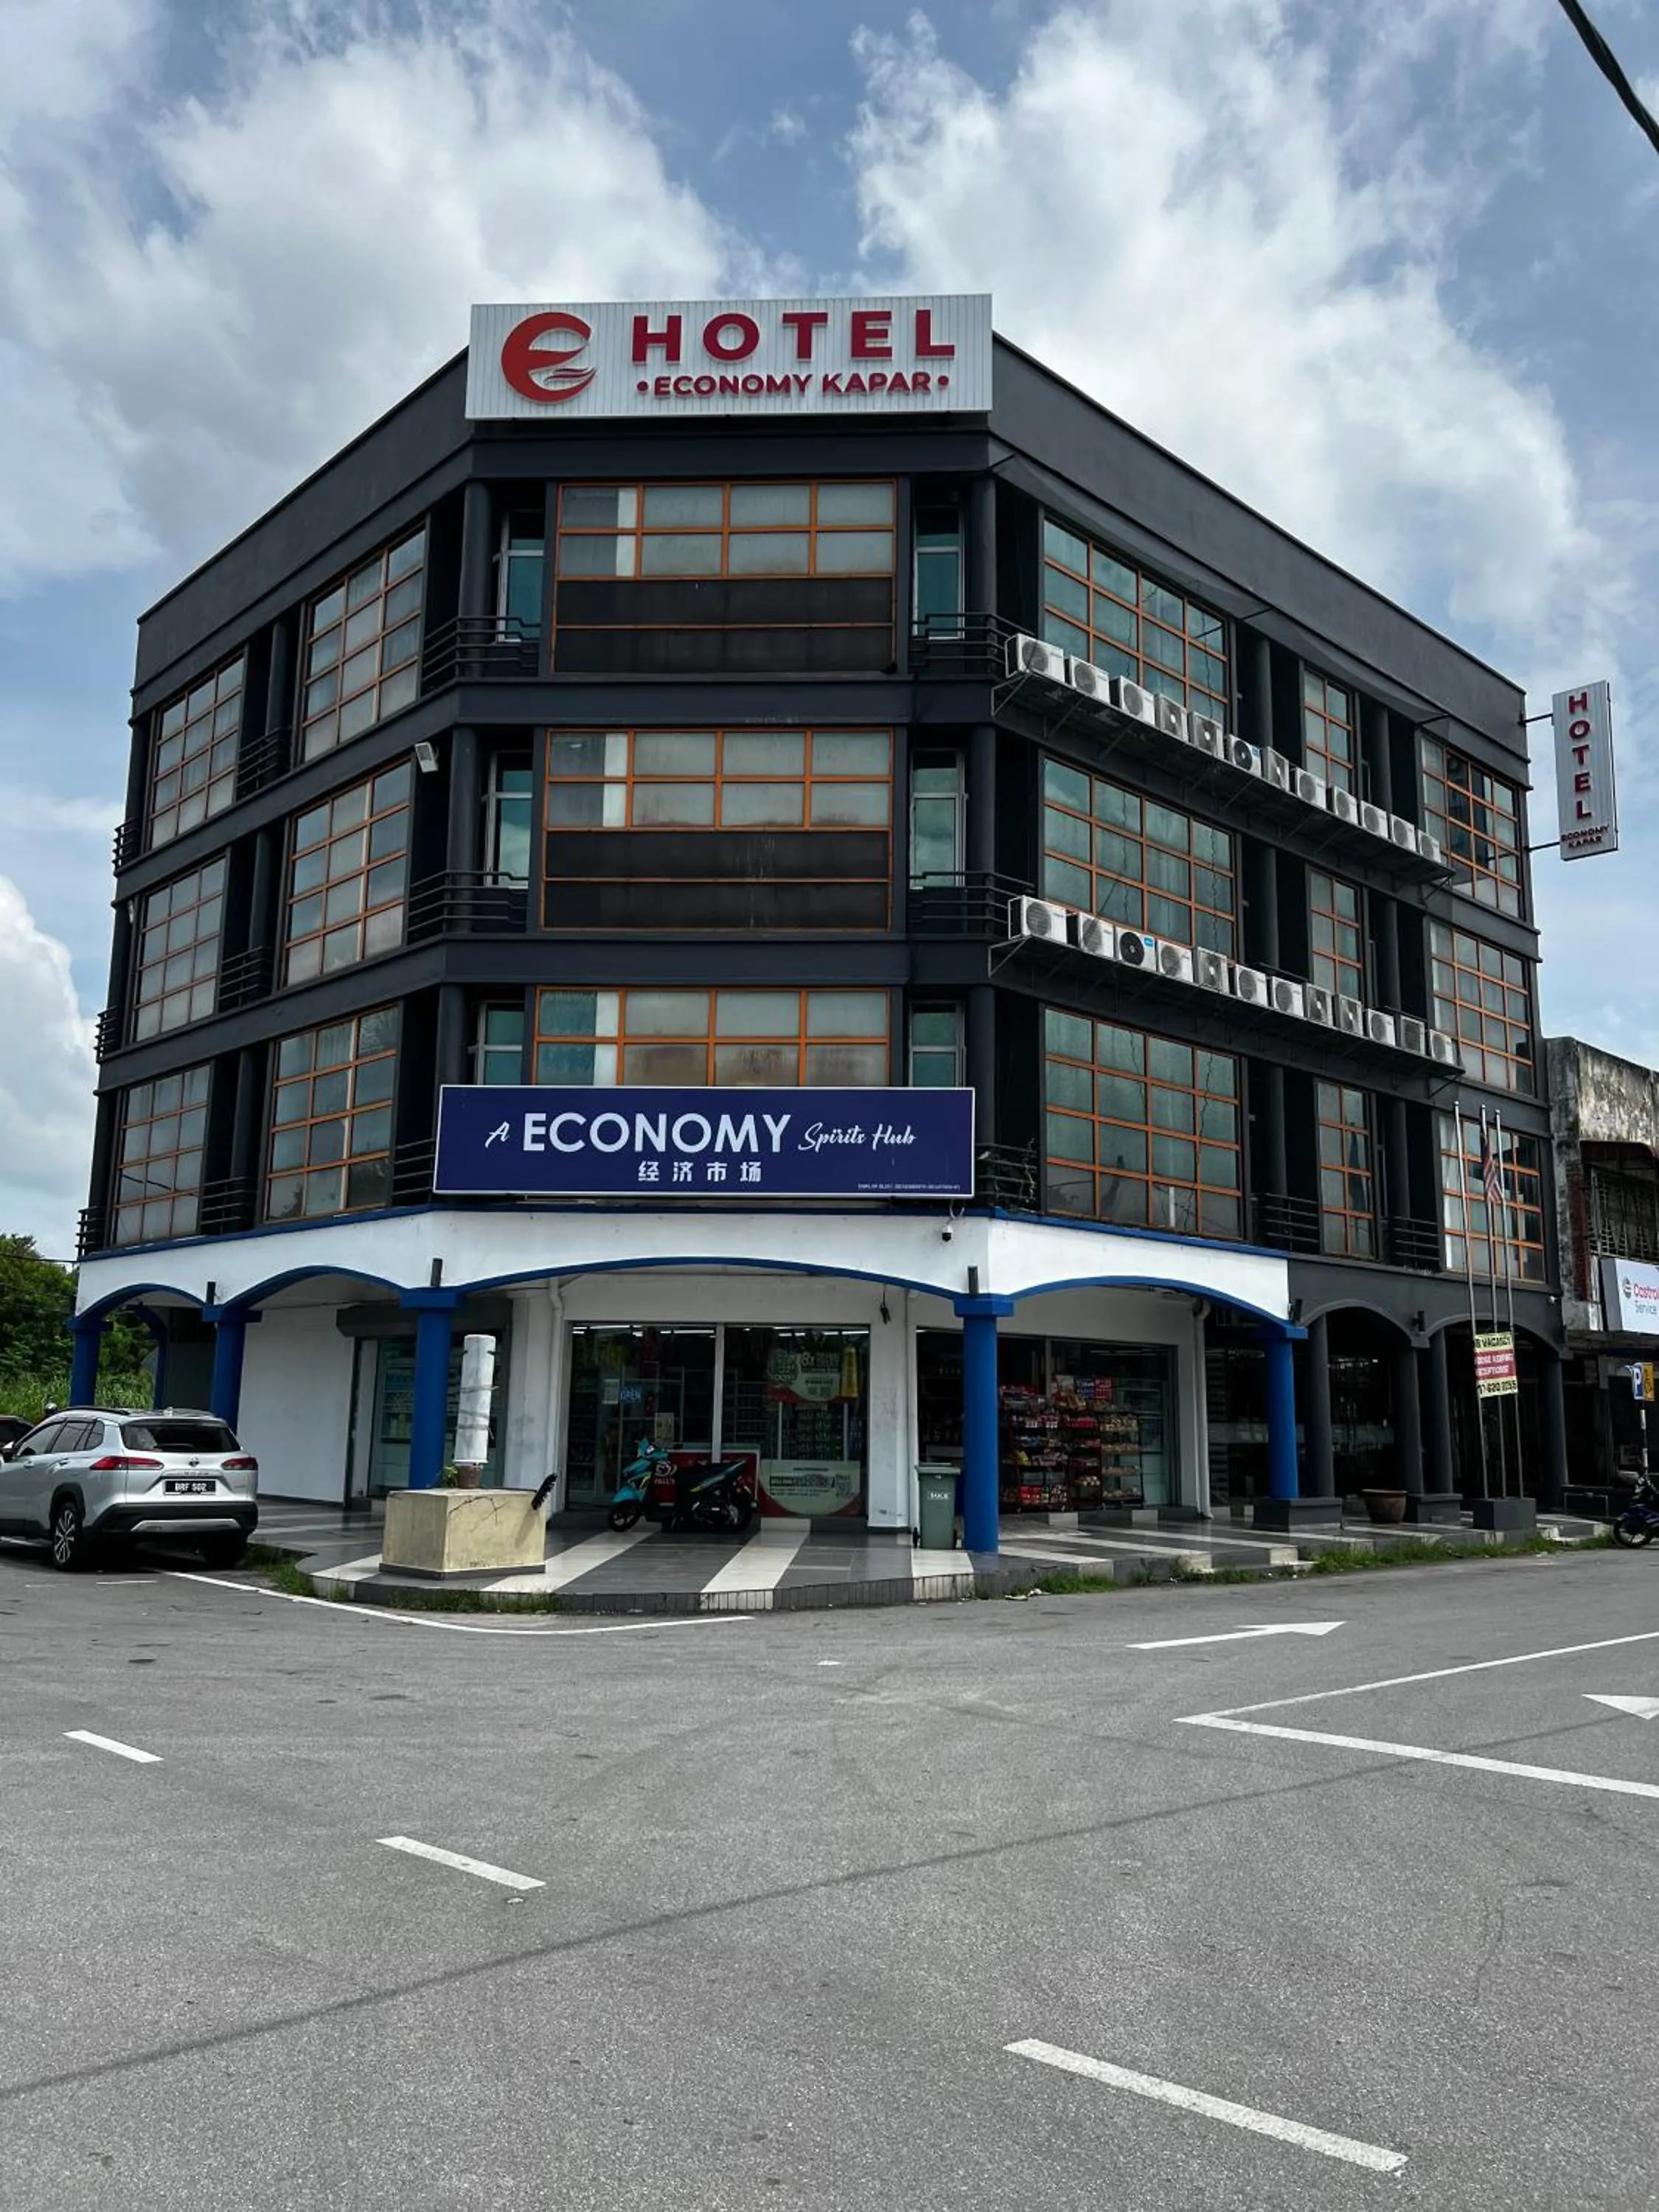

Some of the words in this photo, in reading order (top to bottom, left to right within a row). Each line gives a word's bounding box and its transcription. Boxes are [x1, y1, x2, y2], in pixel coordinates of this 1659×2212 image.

[632, 309, 956, 364] HOTEL
[653, 373, 814, 397] ECONOMY
[822, 372, 932, 394] KAPAR
[1569, 692, 1592, 820] HOTEL
[1561, 824, 1610, 842] ECONOMY
[1568, 835, 1602, 849] KAPAR
[485, 1121, 510, 1149] A
[523, 1112, 791, 1153] ECONOMY
[797, 1121, 866, 1153] Spirits
[872, 1121, 917, 1150] Hub
[638, 1161, 762, 1183] 经济市场
[1633, 1368, 1642, 1394] P
